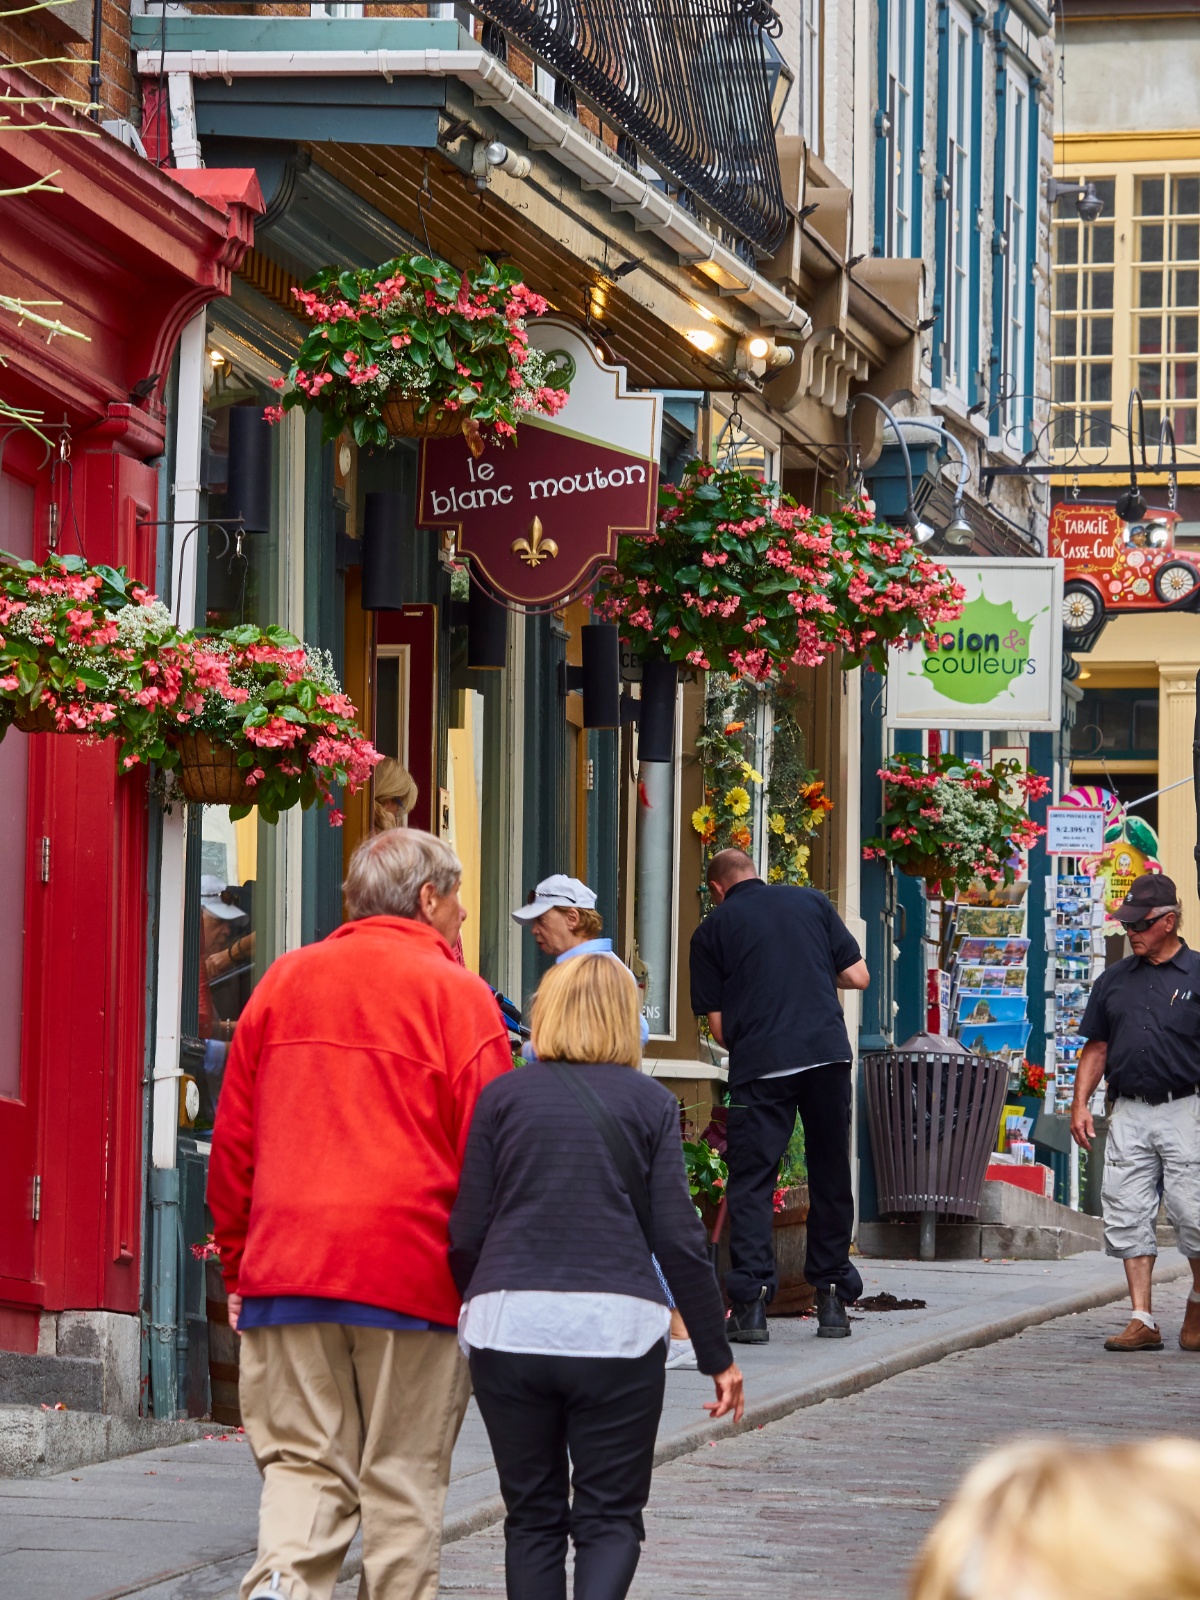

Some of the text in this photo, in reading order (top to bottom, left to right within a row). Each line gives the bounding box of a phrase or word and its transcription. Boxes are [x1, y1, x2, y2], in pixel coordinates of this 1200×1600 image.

[467, 457, 495, 483] le
[431, 464, 646, 516] blanc mouton
[1002, 629, 1026, 653] &
[924, 653, 1036, 674] couleurs
